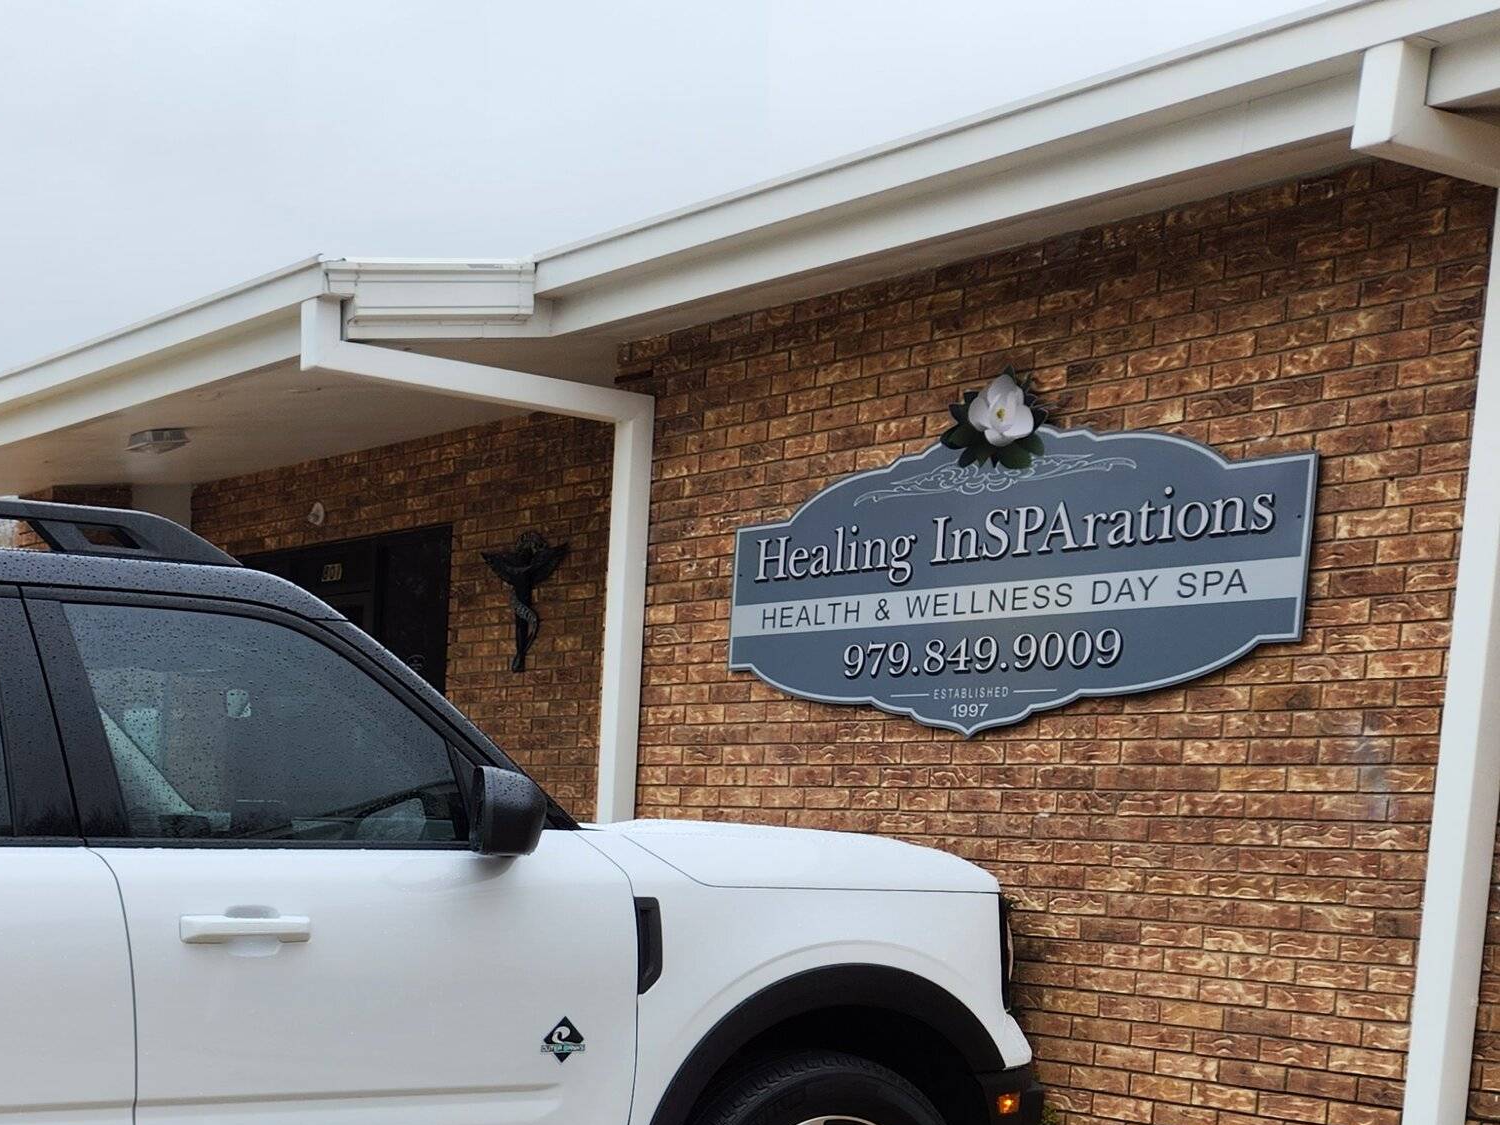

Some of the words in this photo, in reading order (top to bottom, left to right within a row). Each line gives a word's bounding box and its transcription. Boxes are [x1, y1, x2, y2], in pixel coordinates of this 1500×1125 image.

[754, 525, 917, 585] Healing
[930, 486, 1275, 566] InSPArations
[761, 600, 861, 629] HEALTH
[875, 598, 890, 621] &
[906, 583, 1073, 619] WELLNESS
[1091, 575, 1158, 605] DAY
[1177, 568, 1248, 599] SPA
[843, 628, 1122, 678] 979.849.9009
[933, 686, 1009, 700] ESTABLISHED
[950, 704, 989, 718] 1997
